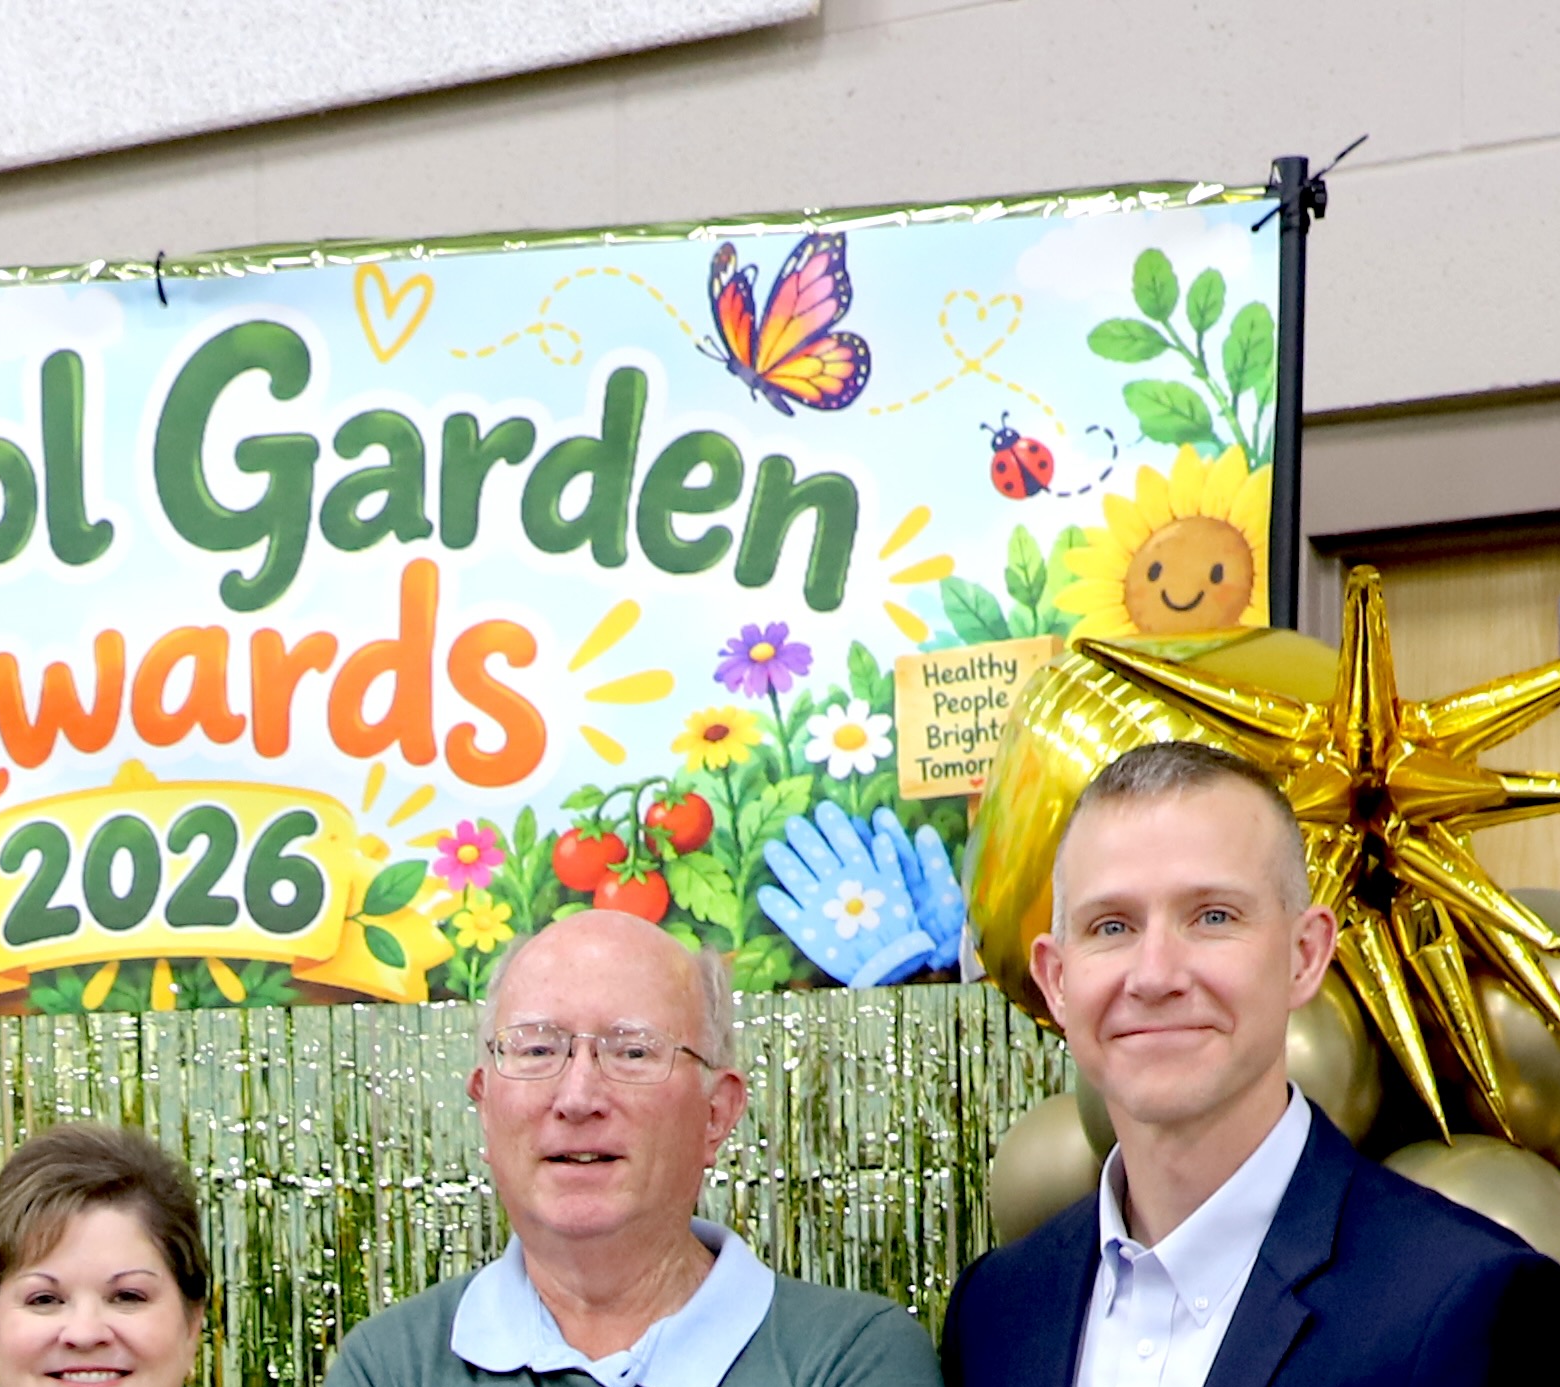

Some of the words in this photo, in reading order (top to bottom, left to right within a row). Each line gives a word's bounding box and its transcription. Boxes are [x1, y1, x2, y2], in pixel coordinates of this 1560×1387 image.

[153, 320, 859, 612] Garden
[922, 652, 1017, 687] Healthy
[933, 687, 1009, 719] People
[926, 716, 1006, 753] Bright
[916, 757, 994, 782] Tomor
[0, 805, 325, 947] 2026
